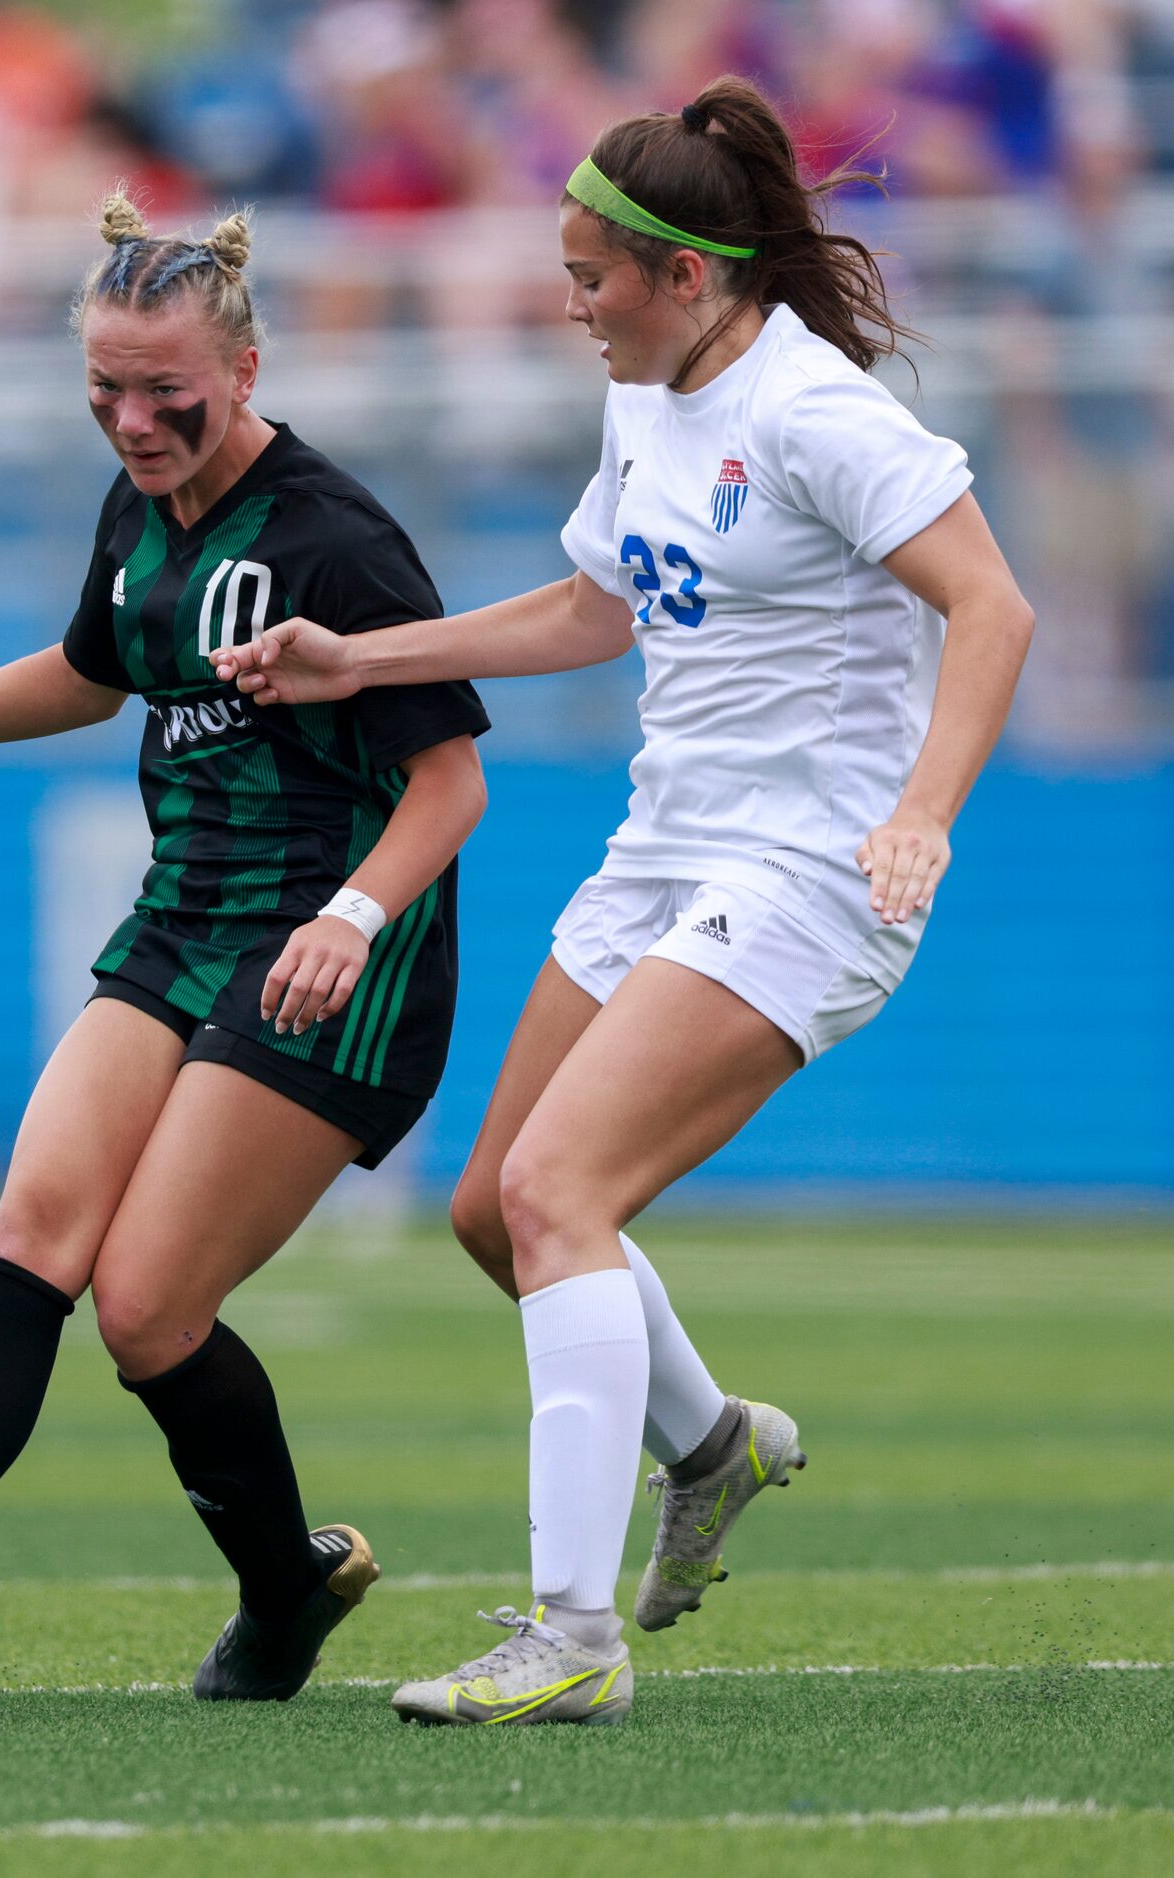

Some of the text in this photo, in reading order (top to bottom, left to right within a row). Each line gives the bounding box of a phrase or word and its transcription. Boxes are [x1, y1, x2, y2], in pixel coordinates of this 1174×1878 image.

[198, 559, 272, 657] 10
[620, 534, 707, 628] 23
[762, 857, 801, 880] AEROREADY
[691, 921, 731, 945] adidas
